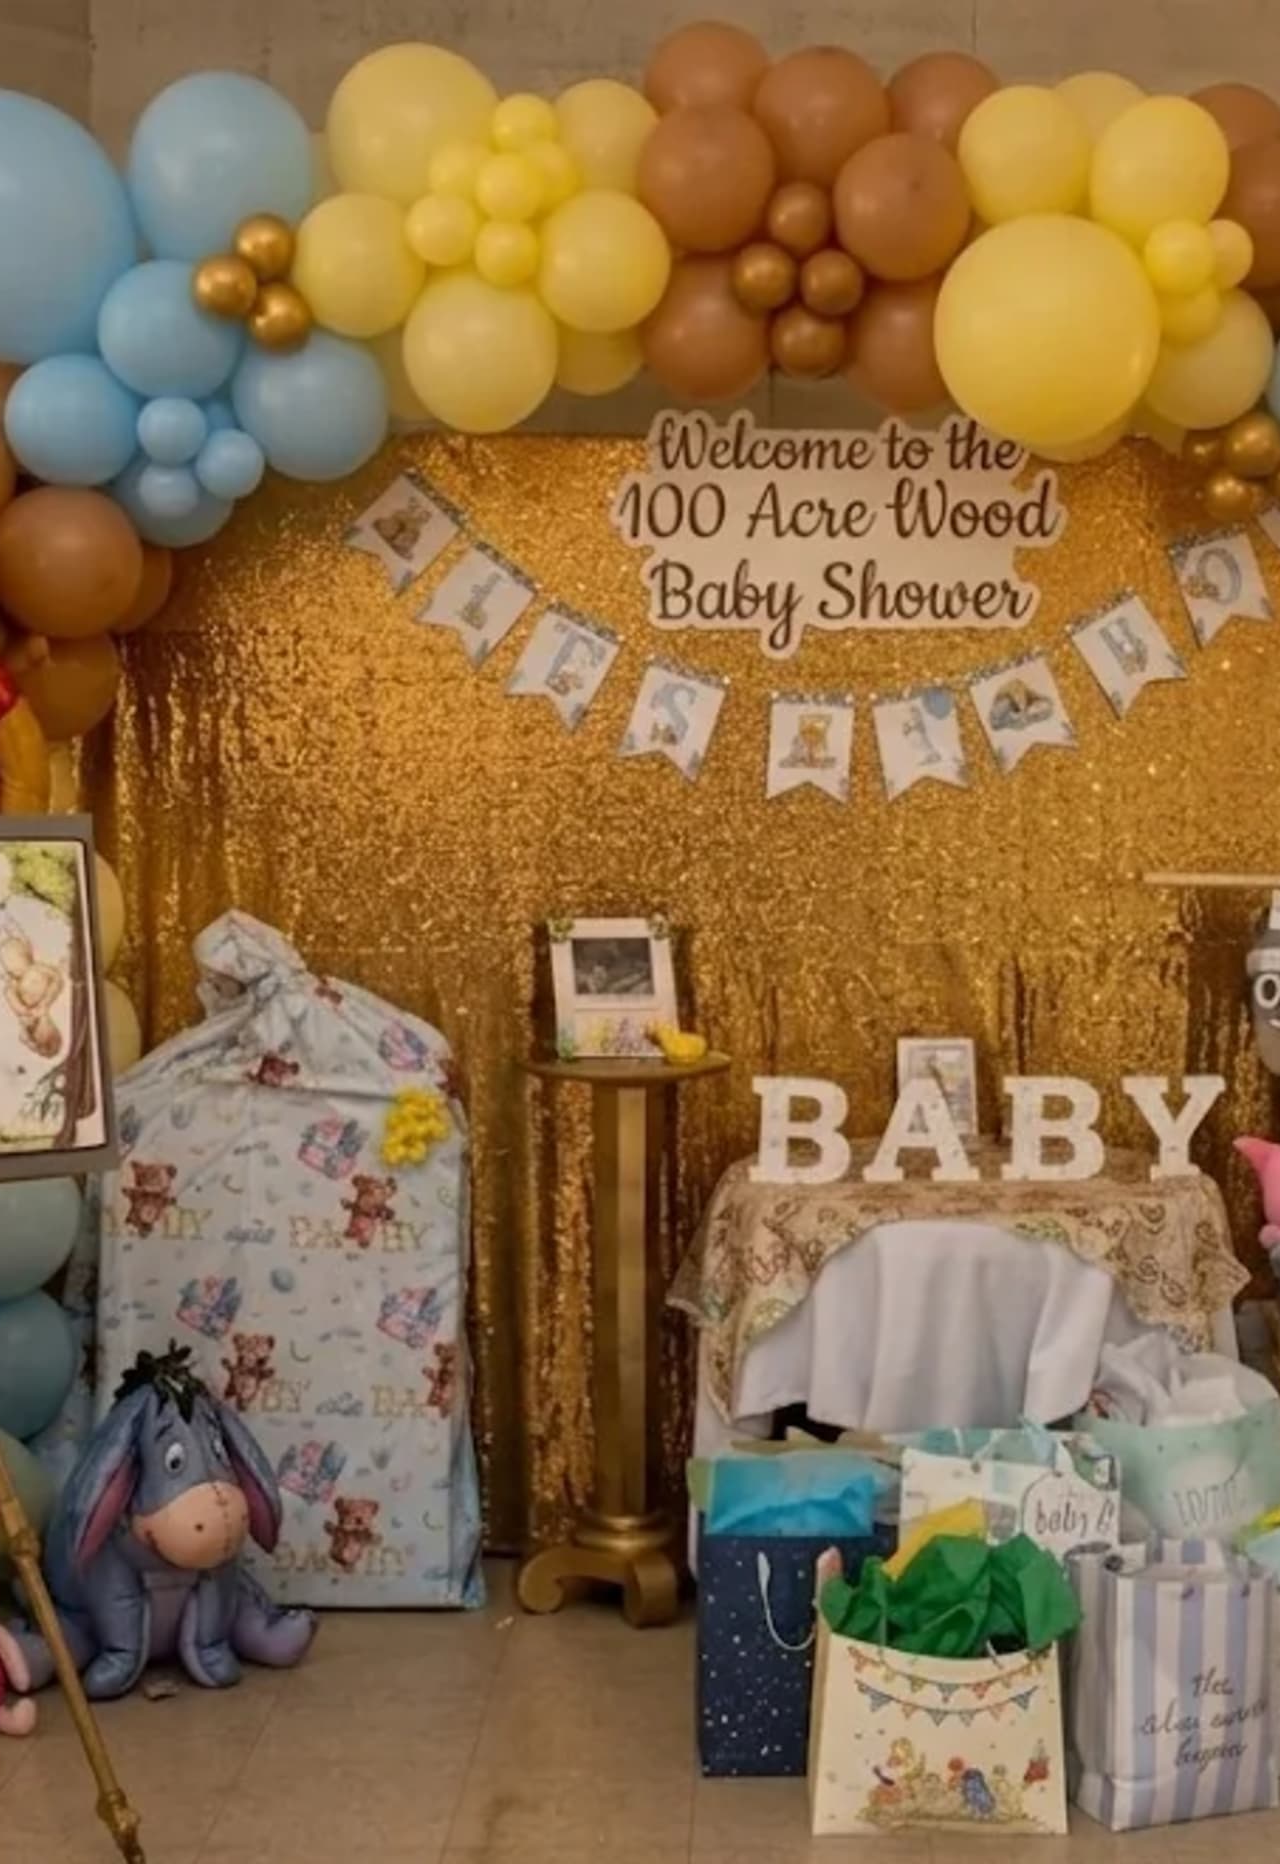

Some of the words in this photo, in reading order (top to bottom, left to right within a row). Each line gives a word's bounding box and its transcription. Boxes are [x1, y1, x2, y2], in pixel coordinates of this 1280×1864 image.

[658, 416, 873, 471] Welcome
[883, 422, 934, 471] to
[945, 421, 1024, 471] the
[619, 481, 727, 539] 100
[745, 481, 878, 540] Acre
[885, 476, 1060, 539] Wood
[649, 557, 804, 651] Baby
[818, 558, 1034, 621] Shower
[748, 1074, 1226, 1184] BABY
